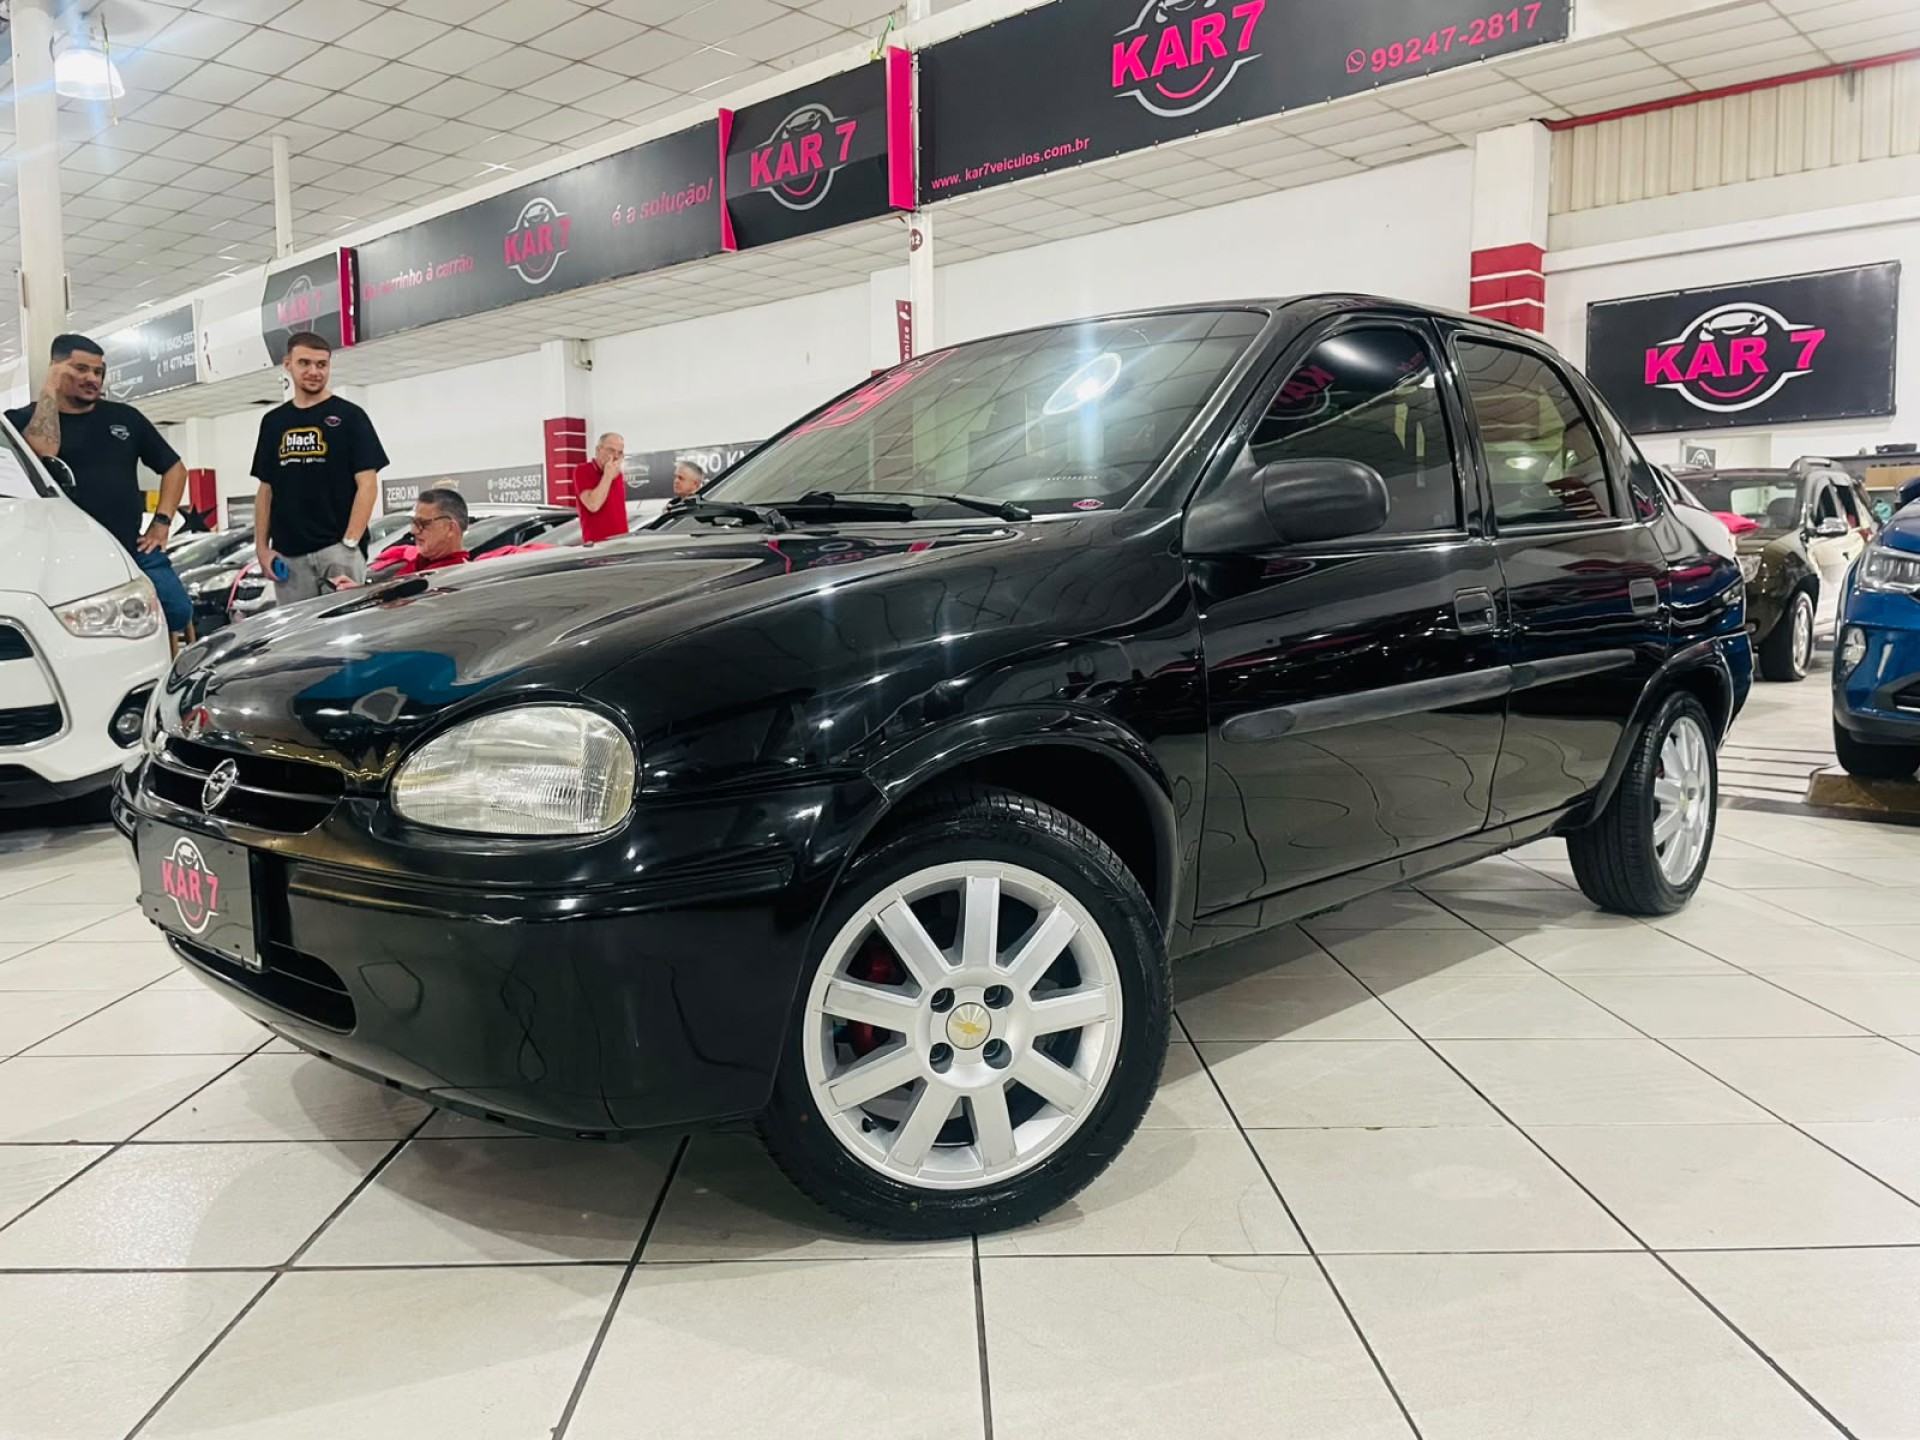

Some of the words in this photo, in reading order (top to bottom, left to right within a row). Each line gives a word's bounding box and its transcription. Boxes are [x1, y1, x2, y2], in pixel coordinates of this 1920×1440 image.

[1370, 2, 1543, 73] 99247-2817
[750, 132, 824, 188] KAR
[835, 120, 858, 162] 7
[626, 206, 636, 224] a
[640, 177, 713, 220] solução!
[504, 221, 554, 266] KAR
[556, 216, 572, 249] 7
[1644, 337, 1769, 385] KAR
[1790, 329, 1826, 370] 7
[286, 432, 316, 446] black
[386, 486, 407, 501] ZERO
[162, 860, 204, 906] KAR
[206, 875, 219, 910] 7
